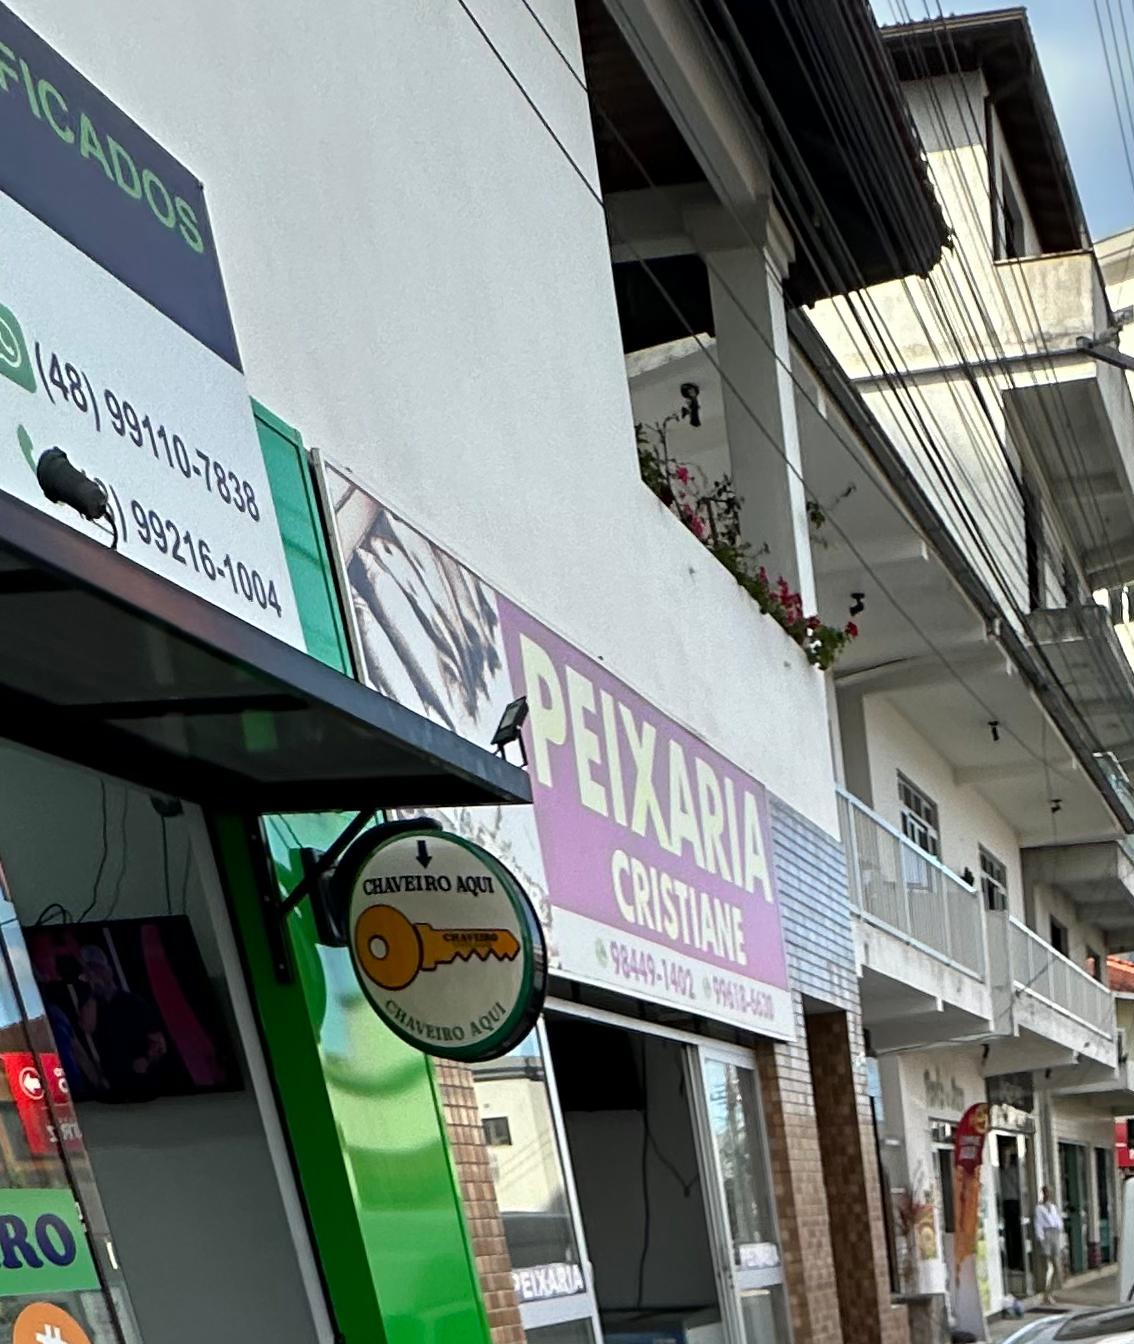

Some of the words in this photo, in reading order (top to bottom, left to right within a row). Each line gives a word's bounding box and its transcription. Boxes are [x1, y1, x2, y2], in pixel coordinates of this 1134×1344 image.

[0, 41, 204, 253] FICADOS
[35, 341, 100, 432] (48)
[104, 389, 260, 522] 99110-7838
[131, 500, 282, 618] 99216-1004
[519, 633, 774, 903] PEIXARIA
[362, 875, 451, 896] CHAVEIRO
[456, 876, 495, 897] AQUI
[611, 849, 748, 966] CRISTIANE
[385, 1000, 465, 1041] CHAVEIRO
[470, 1001, 507, 1037] AQUI
[0, 1213, 77, 1268] RO
